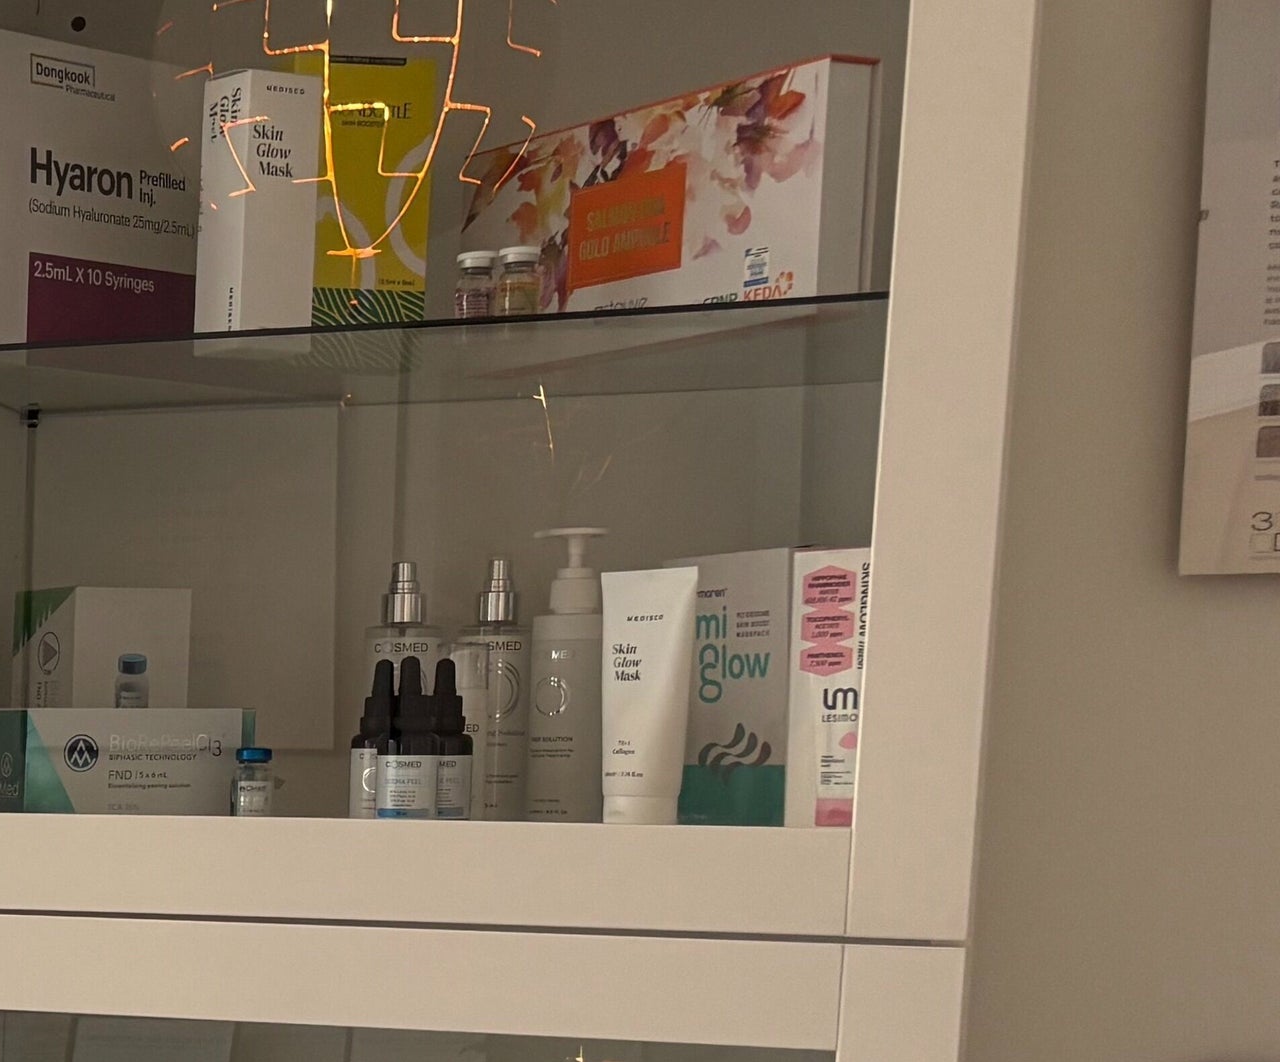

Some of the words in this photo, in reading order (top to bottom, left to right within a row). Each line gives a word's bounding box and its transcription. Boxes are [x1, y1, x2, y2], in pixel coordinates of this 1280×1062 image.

[35, 61, 91, 86] Dongkook
[65, 84, 117, 102] Pharmaceutical
[252, 124, 284, 142] Skin
[256, 142, 292, 161] Glow
[29, 147, 133, 200] Hyaron
[139, 169, 186, 192] Prefilled
[259, 160, 294, 179] Mask
[139, 188, 157, 208] Inj.
[28, 198, 71, 219] (Sodium
[73, 204, 131, 228] Hyaluronate
[33, 261, 74, 283] 2.5mL
[75, 267, 86, 284] X
[87, 268, 102, 286] 10
[104, 271, 155, 295] Syringes
[695, 605, 727, 640] mi
[611, 643, 638, 655] Skin
[613, 656, 643, 668] Glow
[613, 669, 642, 681] Mask
[698, 642, 771, 704] glow
[108, 753, 143, 761] BIPHASIC
[145, 753, 198, 762] TECHNOLOGY
[108, 769, 133, 781] FND
